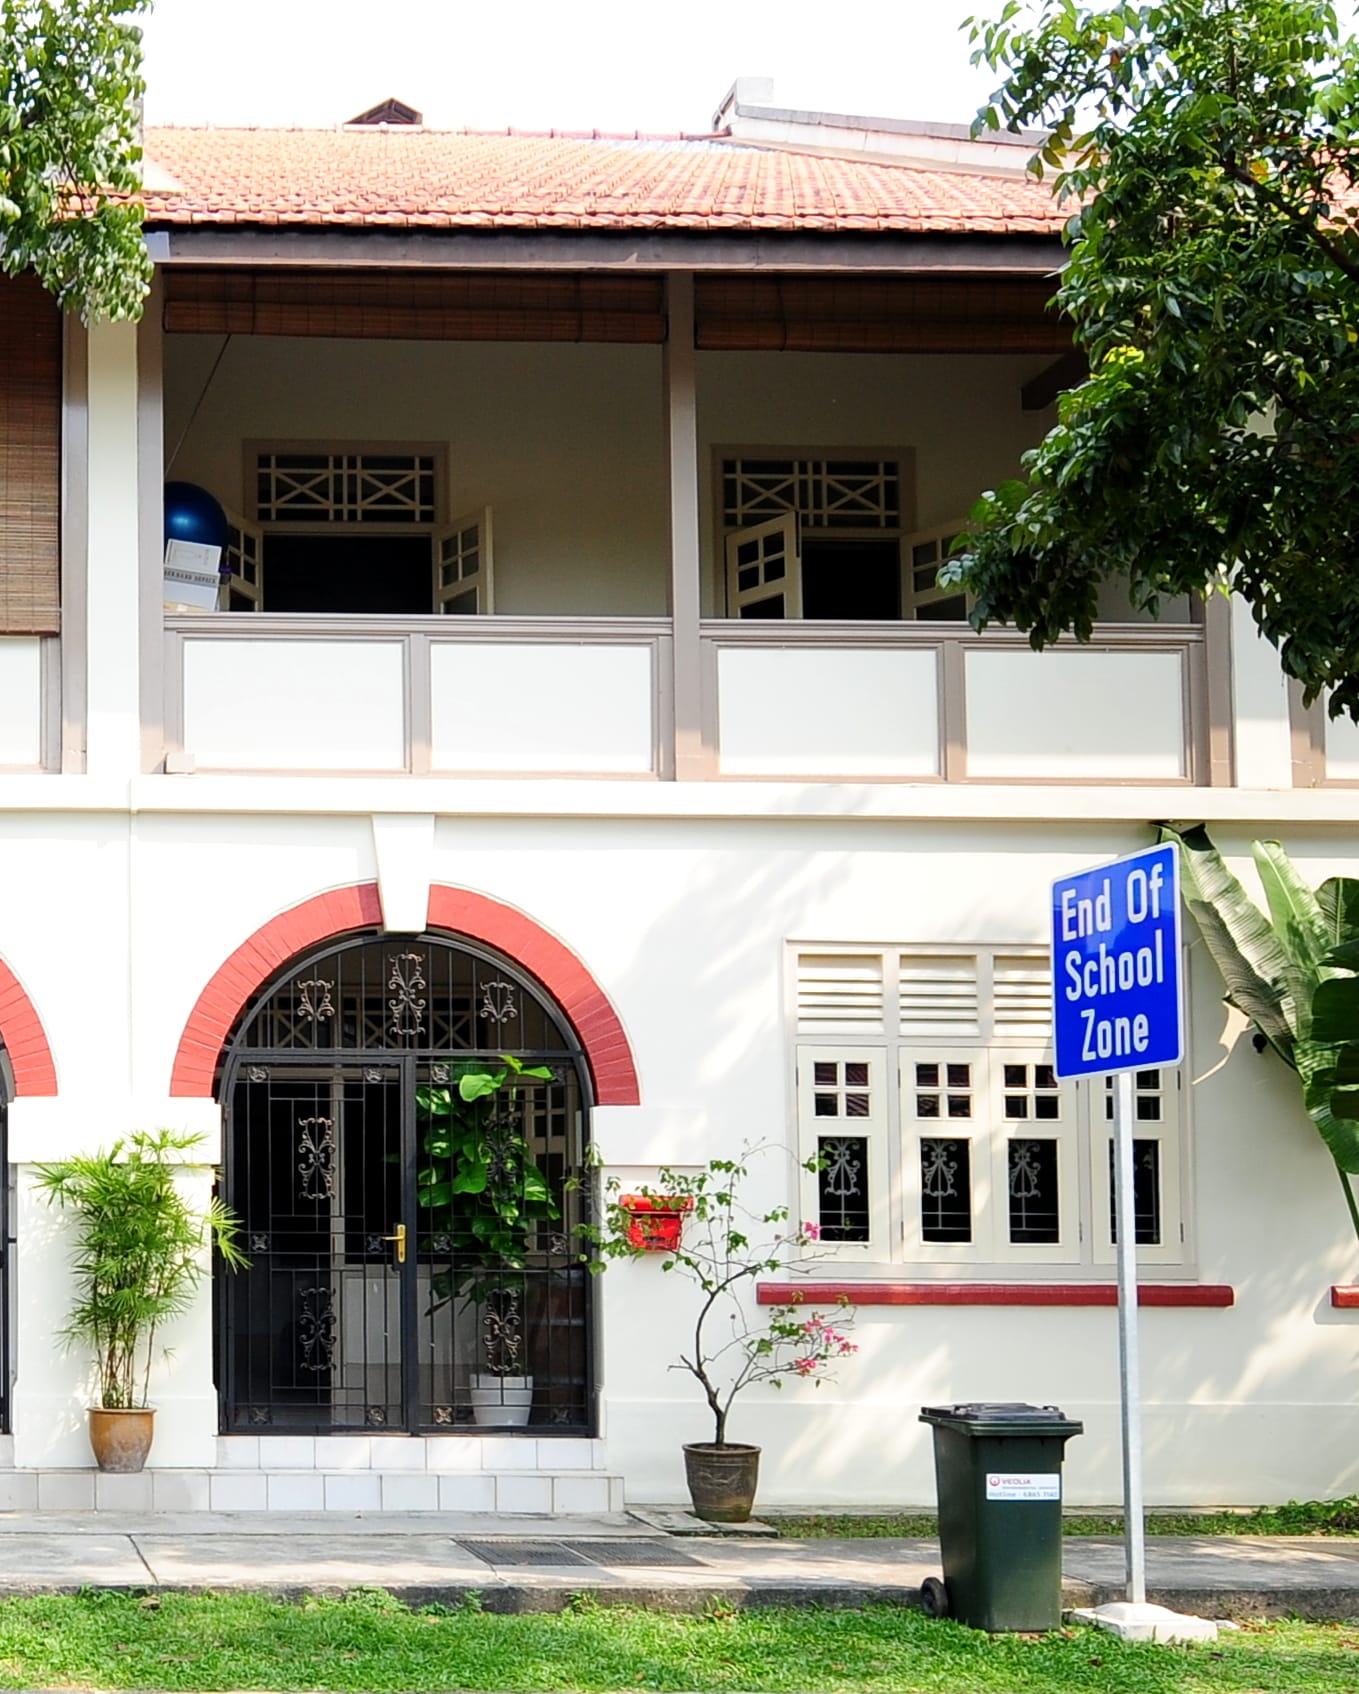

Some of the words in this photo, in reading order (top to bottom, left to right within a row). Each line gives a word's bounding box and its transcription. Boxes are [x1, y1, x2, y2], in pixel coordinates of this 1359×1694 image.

[1061, 878, 1112, 942] End
[1126, 862, 1164, 924] Of
[1065, 928, 1164, 1002] School
[1080, 1008, 1150, 1062] Zone
